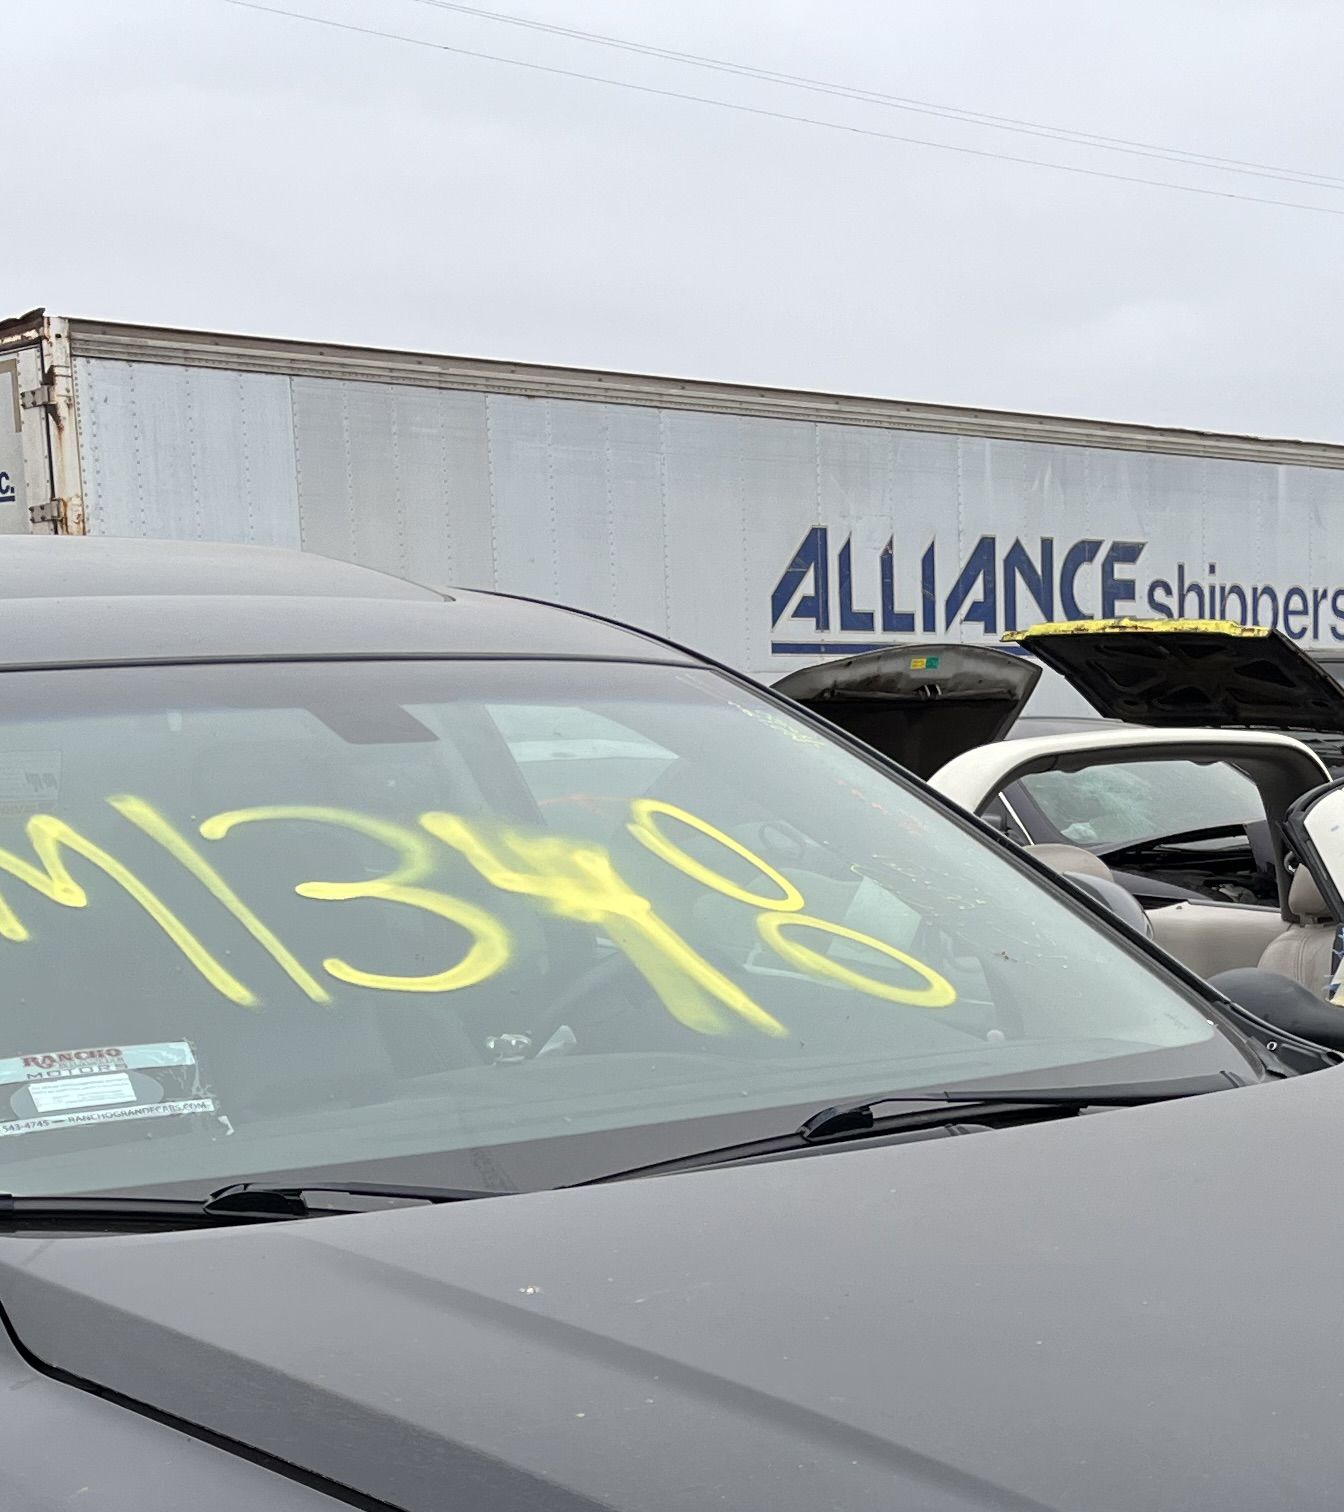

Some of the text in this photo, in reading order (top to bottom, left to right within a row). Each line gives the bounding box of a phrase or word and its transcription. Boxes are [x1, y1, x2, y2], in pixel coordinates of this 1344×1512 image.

[771, 525, 1147, 634] ALLIANCE
[22, 1048, 123, 1069] RANCHO
[27, 1063, 128, 1080] MOTORS
